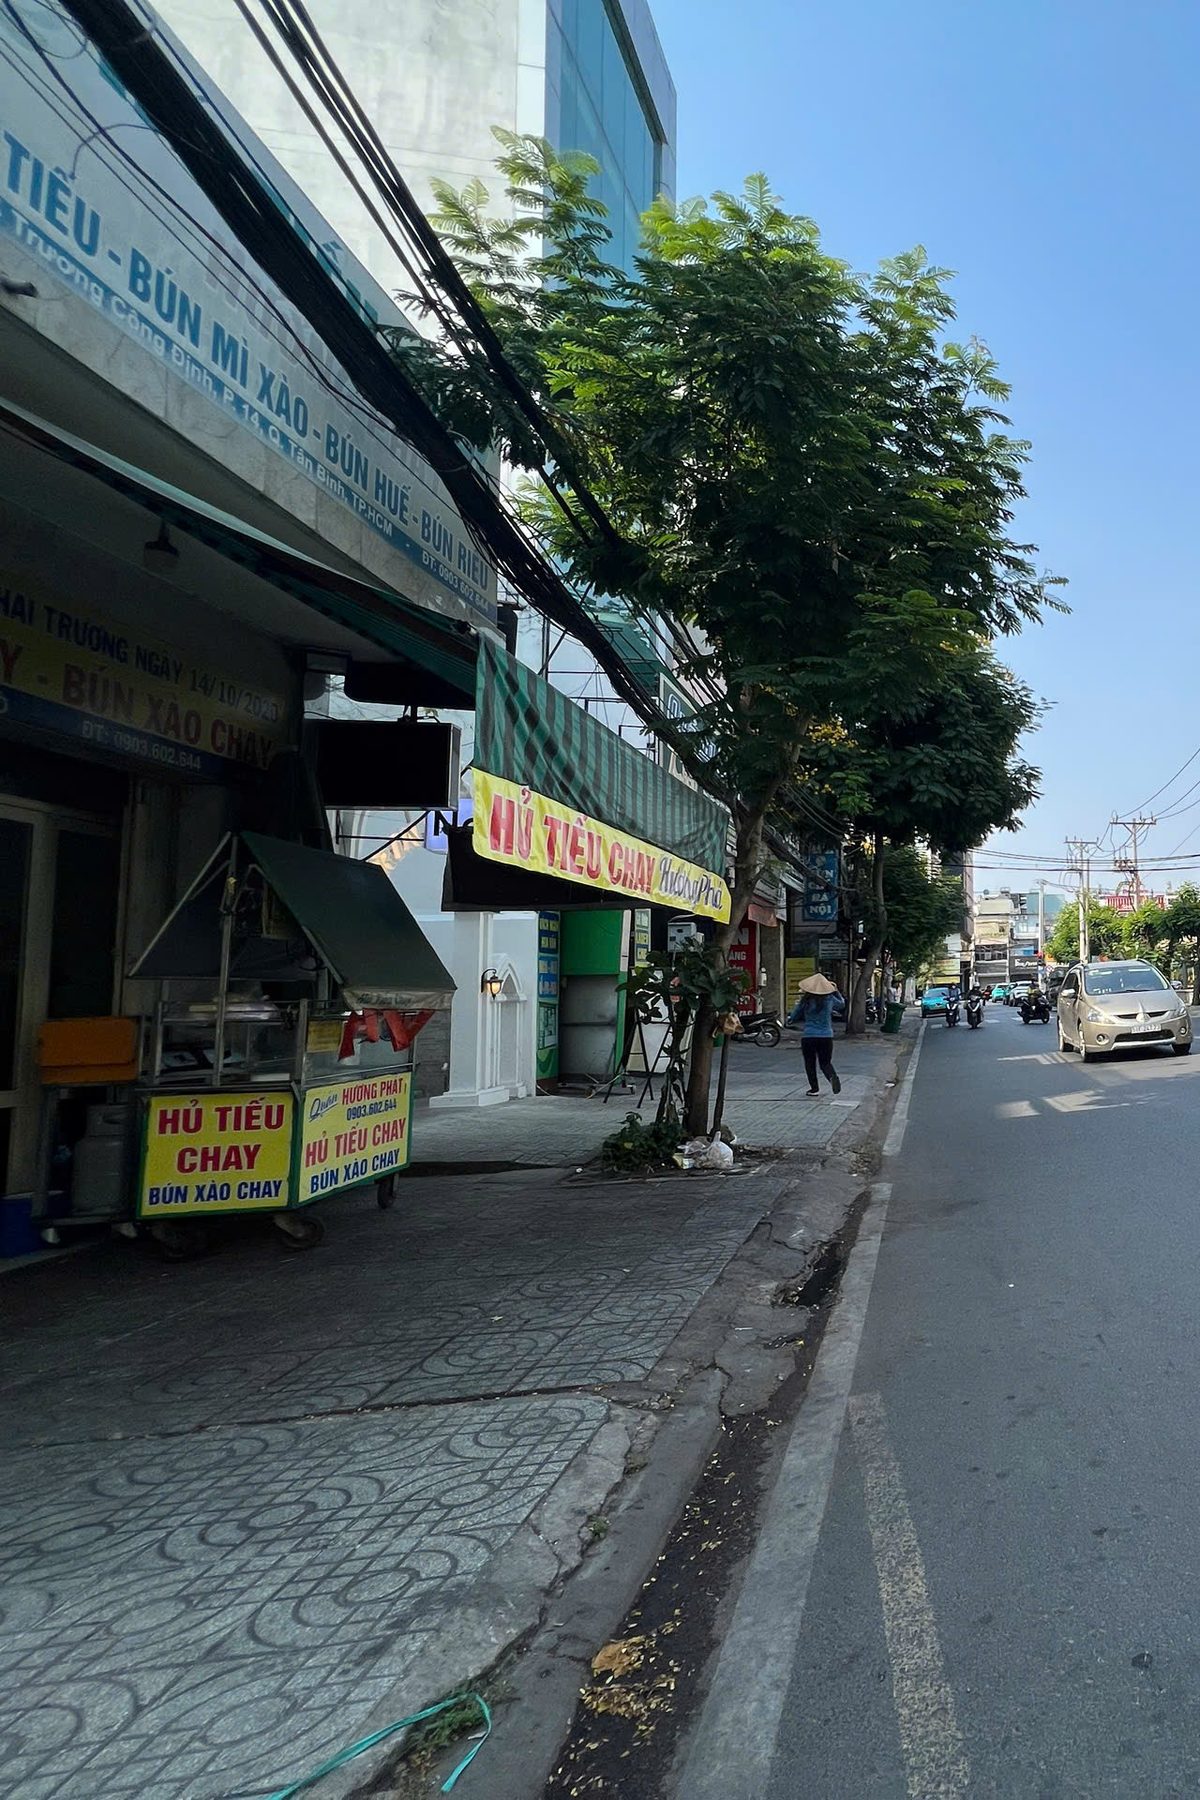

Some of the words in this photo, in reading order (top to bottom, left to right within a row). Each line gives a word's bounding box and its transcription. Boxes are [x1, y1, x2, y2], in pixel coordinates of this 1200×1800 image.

[128, 247, 202, 349] BÚN
[211, 321, 249, 389] MÌ
[256, 362, 309, 439] XÀO
[325, 424, 369, 492] BÚN
[421, 509, 453, 564] BÚN
[488, 786, 534, 861] HỦ
[543, 814, 603, 881] TIẾU
[157, 1098, 204, 1135] HỦ
[214, 1098, 286, 1132] TIẾU
[175, 1143, 263, 1175] CHAY
[304, 1130, 329, 1169] HỦ
[334, 1121, 368, 1157] TIẾU
[371, 1117, 408, 1147] CHAY
[149, 1180, 189, 1206] BÚN
[193, 1180, 232, 1203] XÀO
[236, 1179, 283, 1200] CHAY
[310, 1164, 339, 1195] BÚN
[343, 1157, 368, 1182] XÀO
[371, 1148, 401, 1172] CHAY
